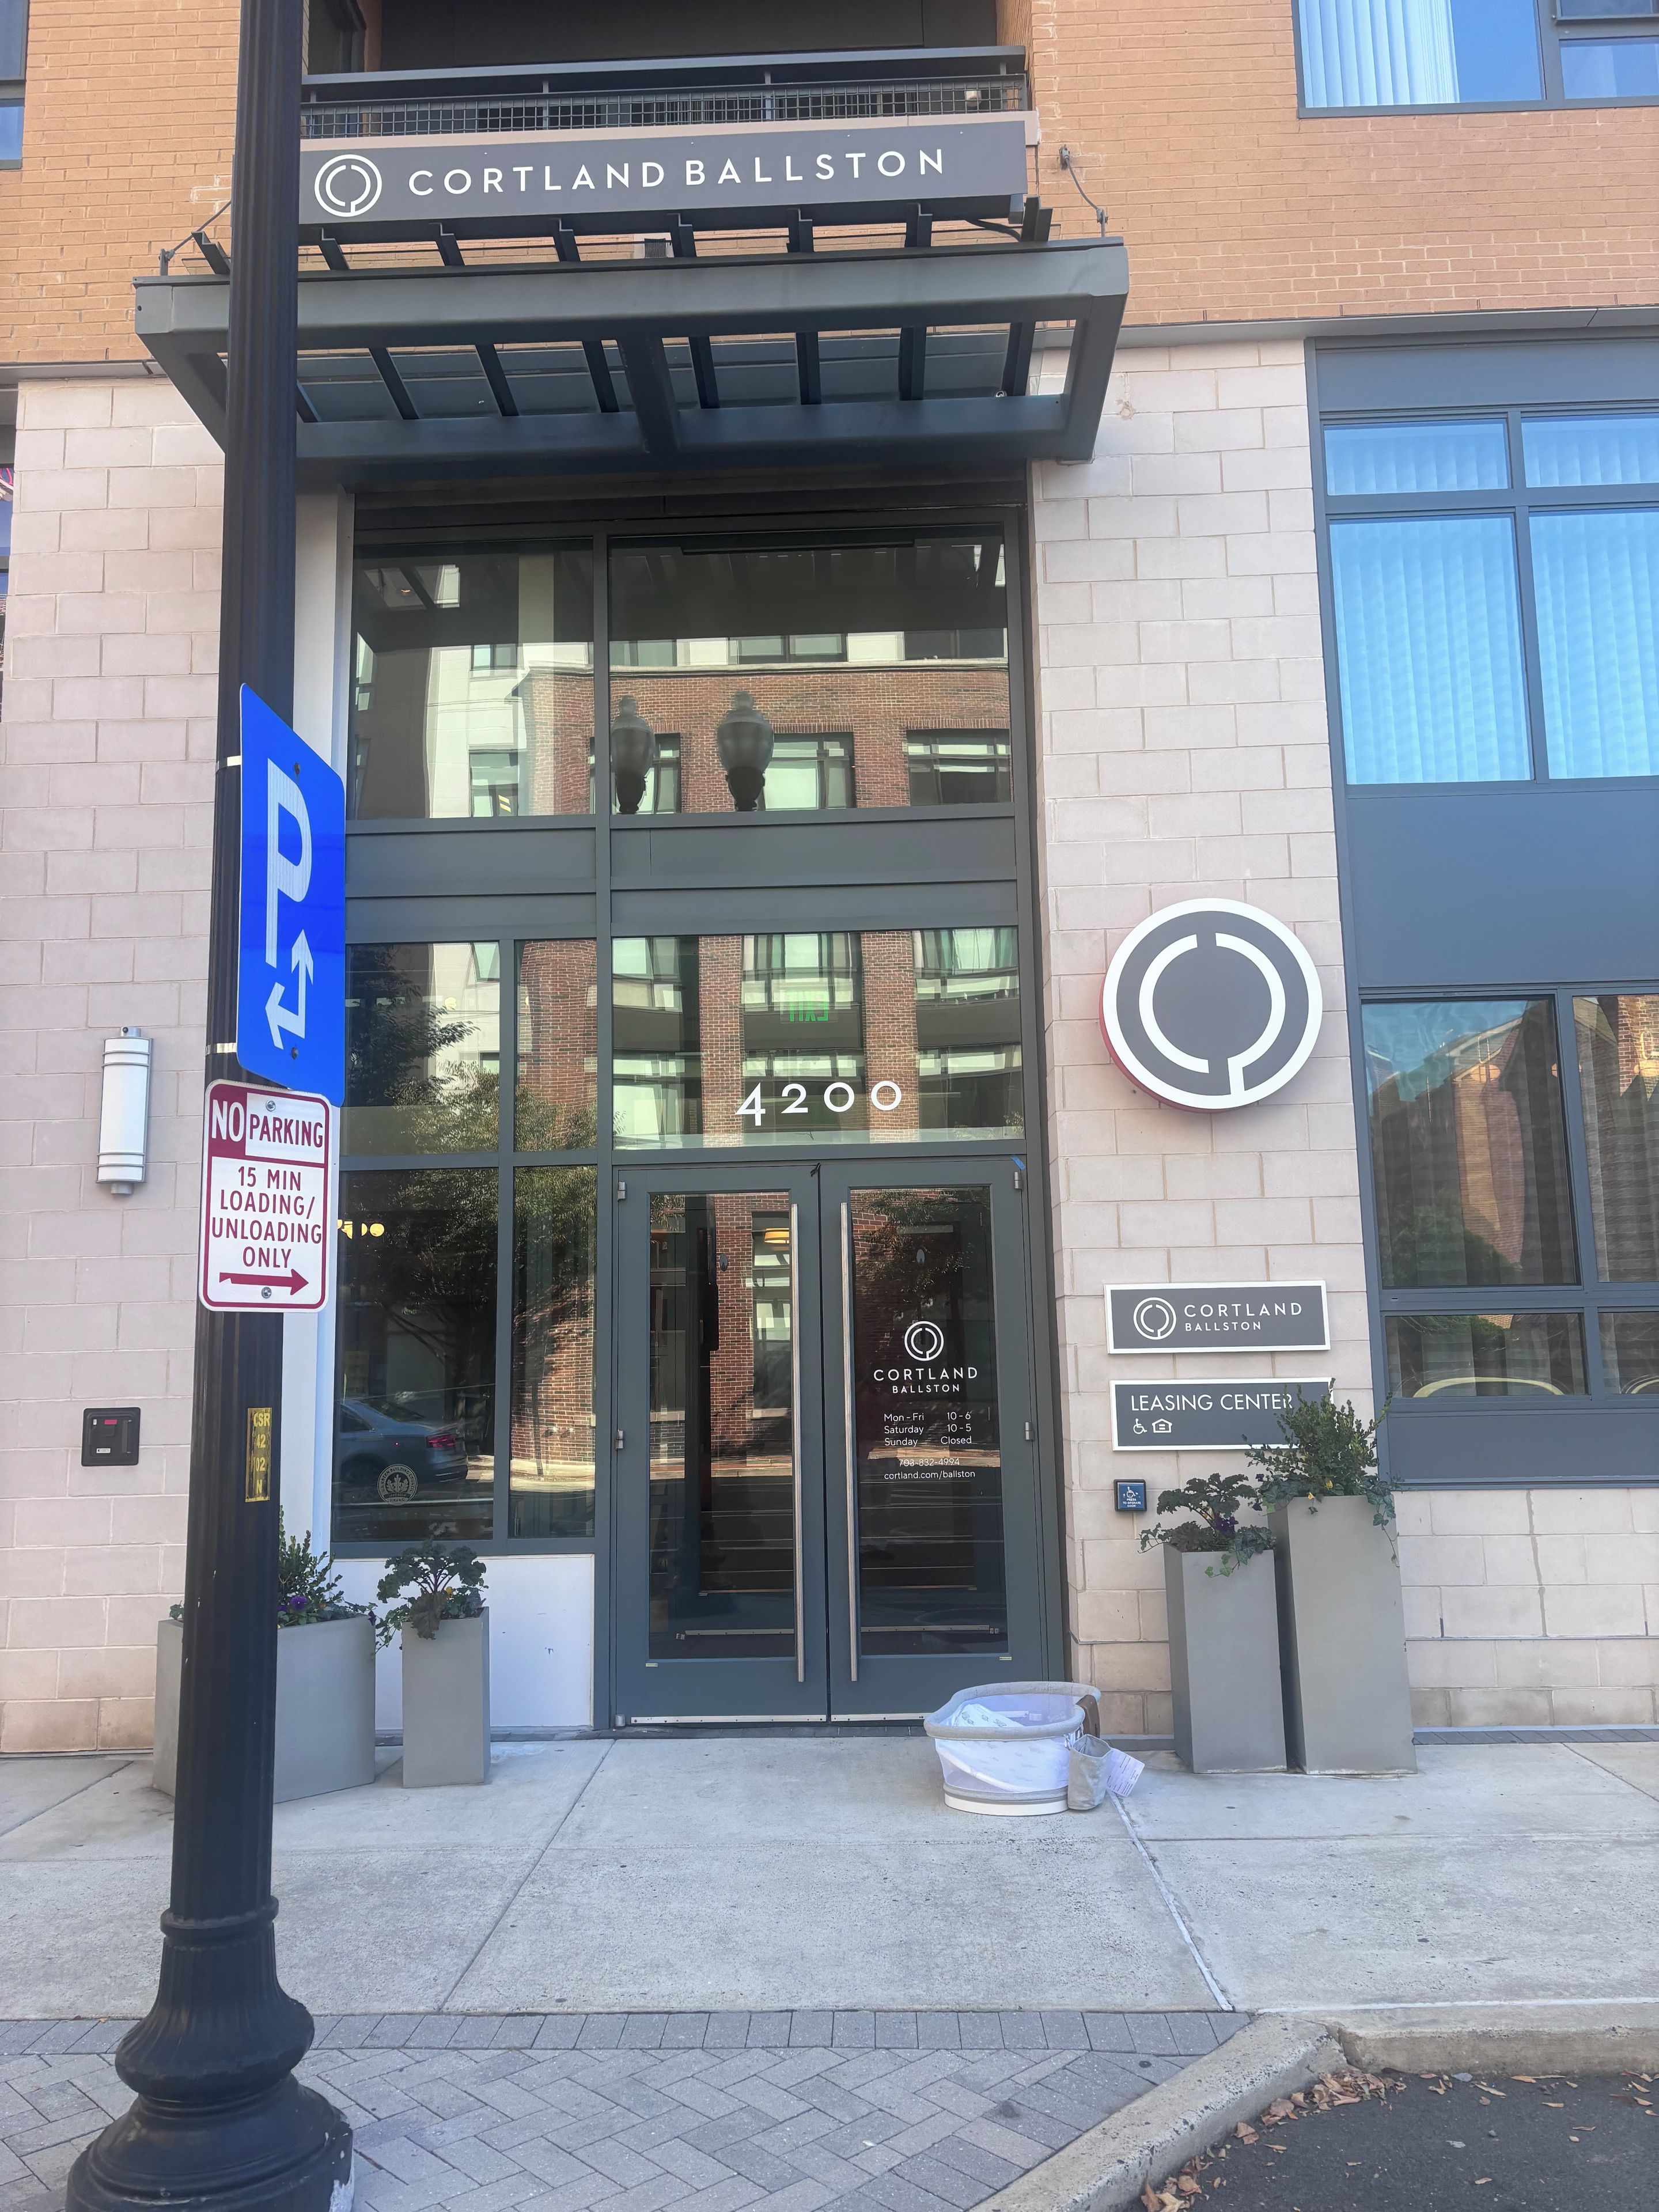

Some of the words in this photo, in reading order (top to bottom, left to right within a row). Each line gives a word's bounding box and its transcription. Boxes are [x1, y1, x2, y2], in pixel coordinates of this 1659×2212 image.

[408, 162, 665, 196] CORTLAND
[686, 149, 943, 185] BALLSTON
[266, 758, 313, 968] P
[735, 1081, 902, 1126] 4200
[211, 1099, 245, 1142] NO
[249, 1113, 323, 1147] PARKING
[238, 1166, 256, 1187] 15
[267, 1169, 301, 1191] MIN
[220, 1189, 315, 1219] LOADING/
[211, 1217, 321, 1244] UNLOADING
[243, 1247, 291, 1268] ONLY
[1184, 1302, 1302, 1317] CORTLAND
[1185, 1321, 1262, 1332] BALLSTON
[873, 1367, 978, 1381] CORTLAND
[892, 1384, 960, 1393] BALLSTON
[1131, 1394, 1213, 1411] LEASING
[1220, 1393, 1293, 1410] CENTER
[253, 1412, 270, 1427] CSR
[884, 1414, 904, 1422] Mon
[912, 1412, 924, 1421] Fri
[947, 1412, 957, 1420] 10
[965, 1411, 971, 1420] 6
[884, 1425, 924, 1435] Saturday
[947, 1424, 957, 1432] 10
[965, 1424, 971, 1432] 5
[885, 1437, 918, 1447] Sunday
[941, 1436, 972, 1445] Closed
[256, 1457, 266, 1472] 02
[899, 1457, 960, 1467] 703-832-4994
[884, 1469, 975, 1480] cortland.com/ballston
